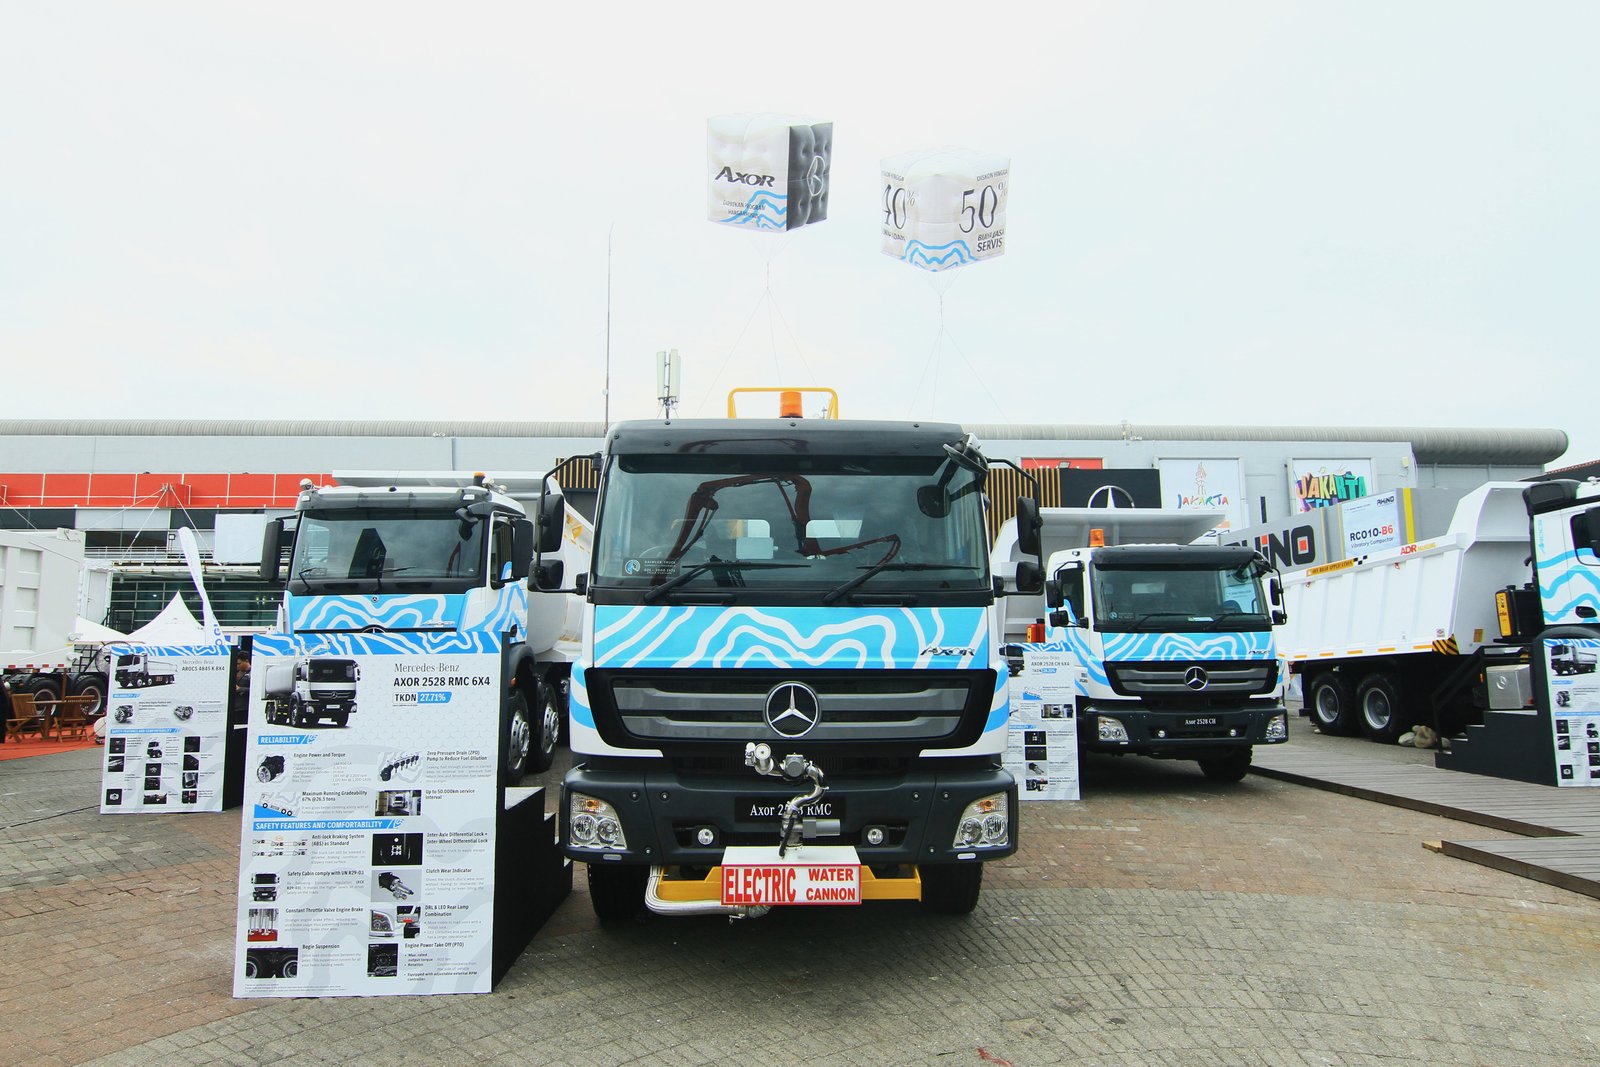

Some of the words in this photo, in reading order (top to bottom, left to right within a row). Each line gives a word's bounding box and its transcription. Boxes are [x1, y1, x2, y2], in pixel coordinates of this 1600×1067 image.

[976, 238, 1002, 252] SERVIS
[1296, 472, 1367, 500] JAKARTA
[1178, 494, 1229, 509] JAKARTA
[1400, 544, 1417, 555] ADR
[394, 663, 460, 672] Mercedes-Benz
[394, 678, 420, 686] AXOR
[422, 677, 446, 686] 2528
[448, 676, 469, 686] RMC
[472, 676, 490, 685] 6X4
[750, 804, 775, 816] Axor
[807, 803, 832, 816] RMC
[726, 868, 796, 902] ELECTRIC
[808, 868, 853, 881] WATER
[806, 887, 855, 900] CANNON
